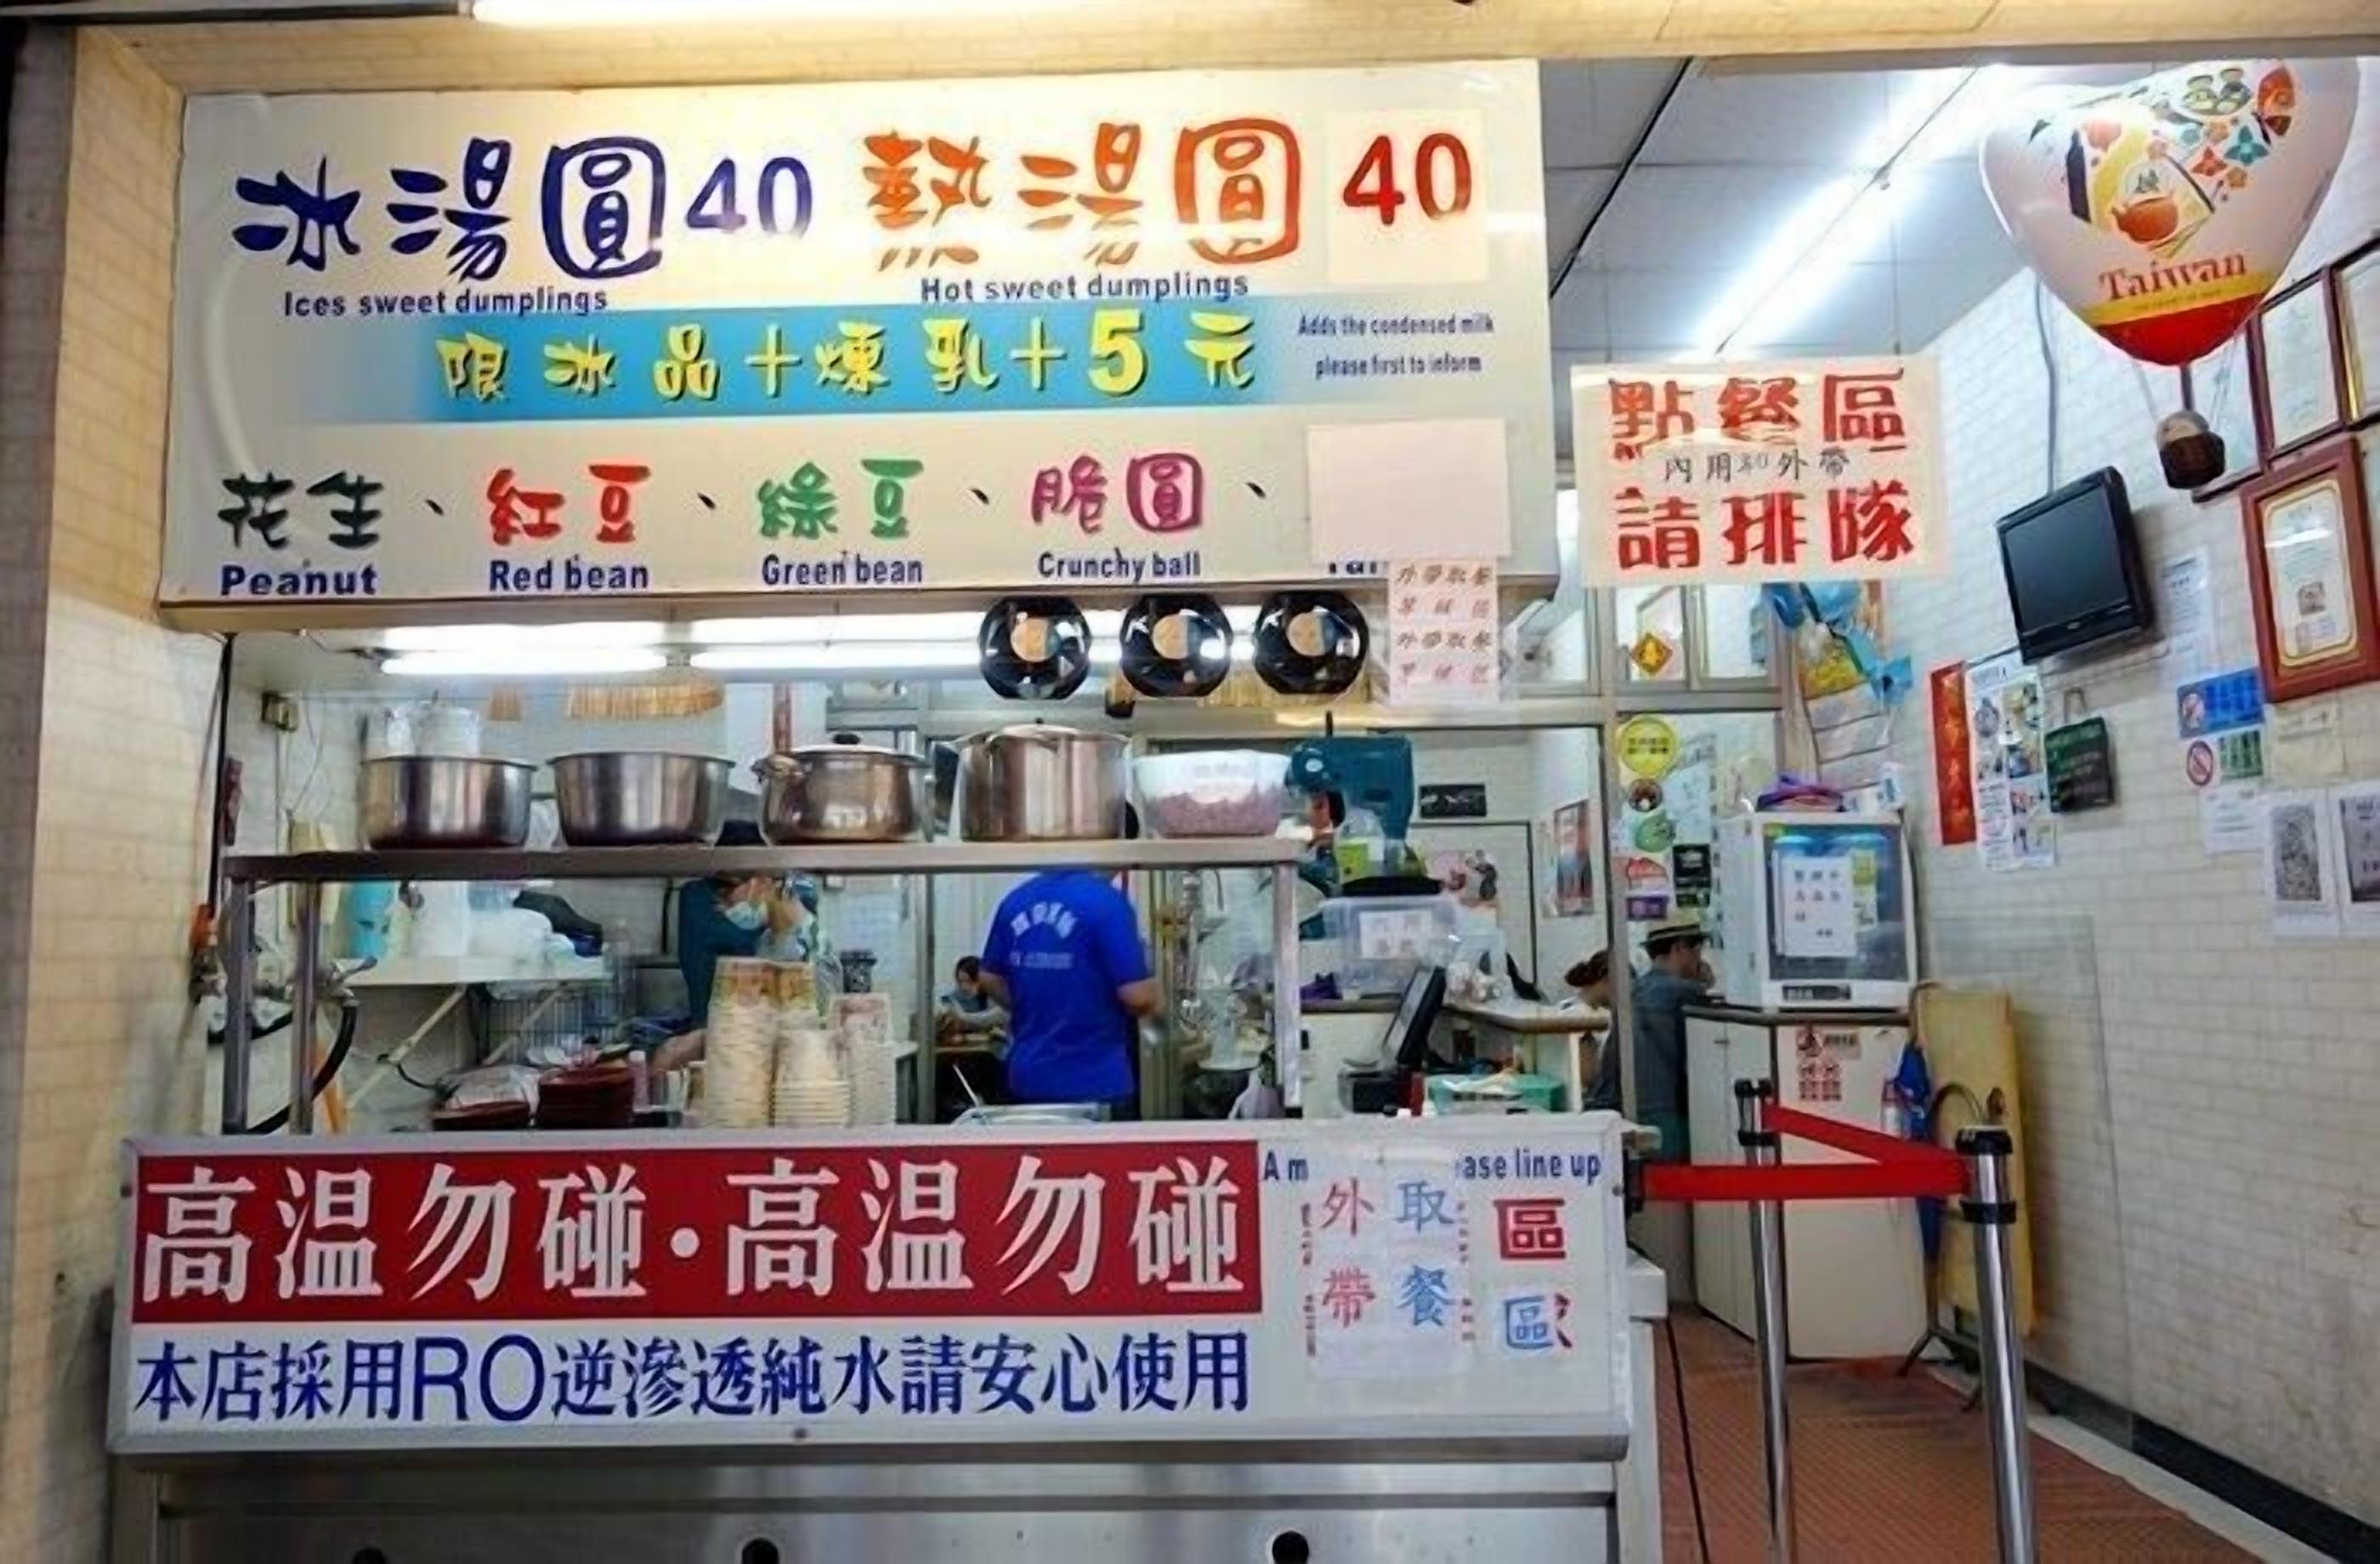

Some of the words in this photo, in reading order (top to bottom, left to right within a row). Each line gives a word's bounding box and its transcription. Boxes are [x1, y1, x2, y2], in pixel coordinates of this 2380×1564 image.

[1341, 132, 1473, 227] 40
[921, 278, 974, 304] Hot
[984, 275, 1077, 301] sweet
[1086, 271, 1250, 305] dumplings
[2098, 253, 2247, 299] Taiwan
[284, 291, 346, 318] Ices
[359, 290, 447, 318] sweet
[455, 282, 609, 320] dumplings
[1608, 368, 1907, 461] 點餐區
[217, 471, 384, 551] 花生
[486, 463, 651, 547] 紅豆
[756, 459, 924, 541] 綠豆
[1616, 479, 1914, 570] 請排隊
[220, 564, 377, 596] Peanut
[490, 559, 552, 592] Red
[564, 558, 649, 591] bean
[761, 553, 847, 586] Green
[854, 552, 923, 584] bean
[1037, 550, 1144, 585] Crunchy
[1152, 551, 1202, 578] ball
[1515, 1148, 1562, 1179] line
[1570, 1154, 1602, 1187] up
